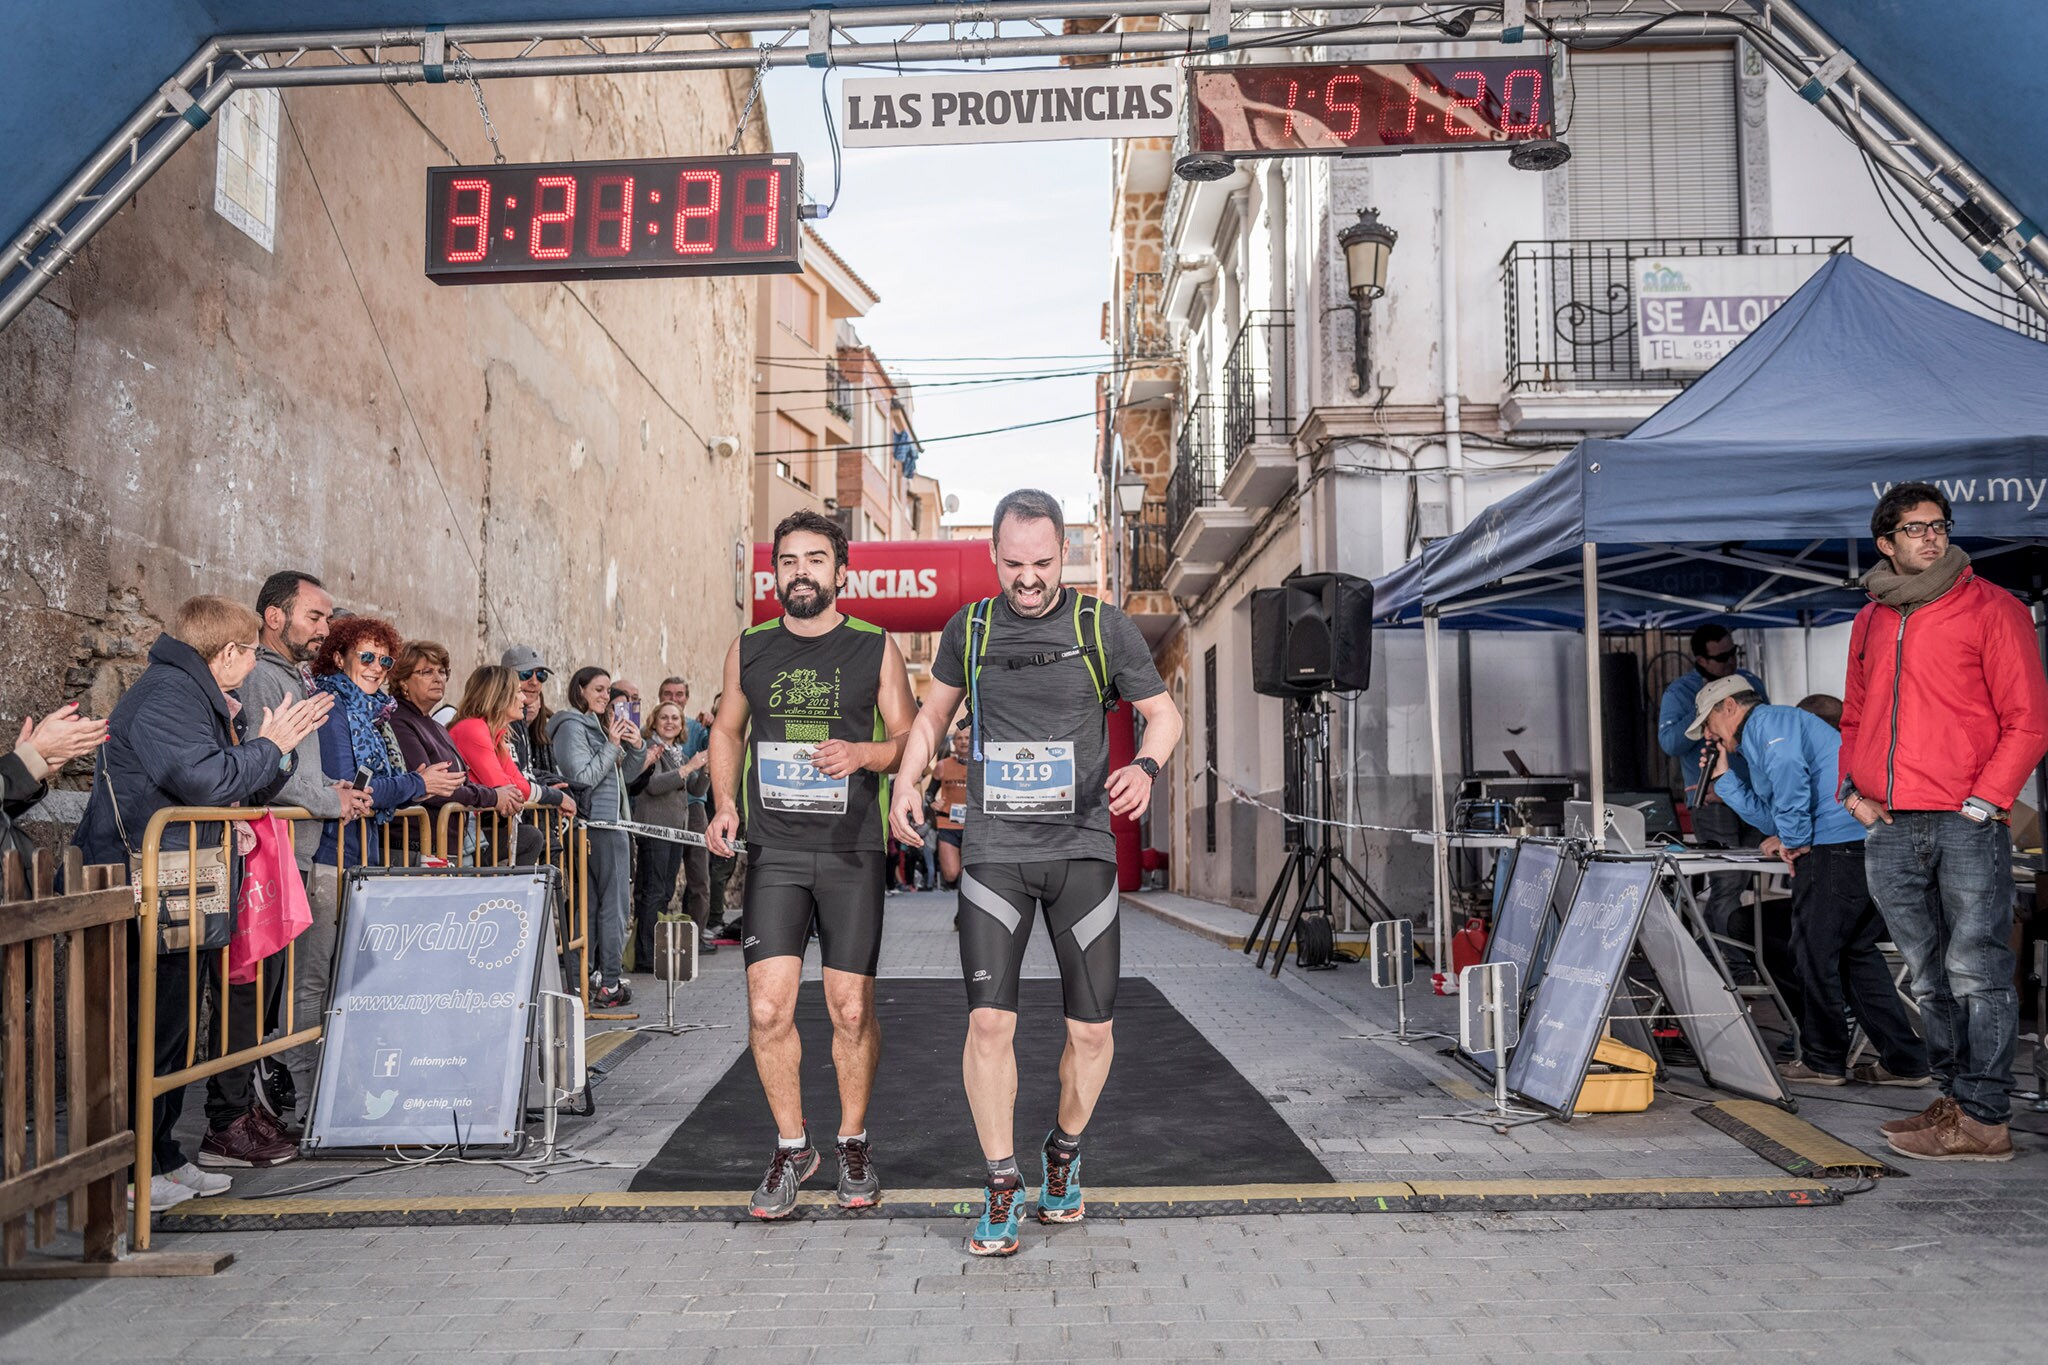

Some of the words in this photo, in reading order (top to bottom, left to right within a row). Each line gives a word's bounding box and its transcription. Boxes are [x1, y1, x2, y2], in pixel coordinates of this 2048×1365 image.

[848, 93, 922, 130] LAS
[932, 84, 1174, 127] PROVINCIAS
[447, 169, 780, 262] 3:21:21
[1646, 300, 1685, 333] SE
[1871, 477, 2048, 511] ww.my
[753, 569, 937, 601] PNCIAS
[807, 698, 829, 706] 2013
[833, 667, 841, 716] ALZIRA
[1001, 763, 1052, 782] 1219
[359, 911, 499, 961] mychip
[348, 989, 516, 1014] www.mychip.es
[410, 1055, 468, 1068] /infomychip
[402, 1097, 473, 1110] @Mychip_Info
